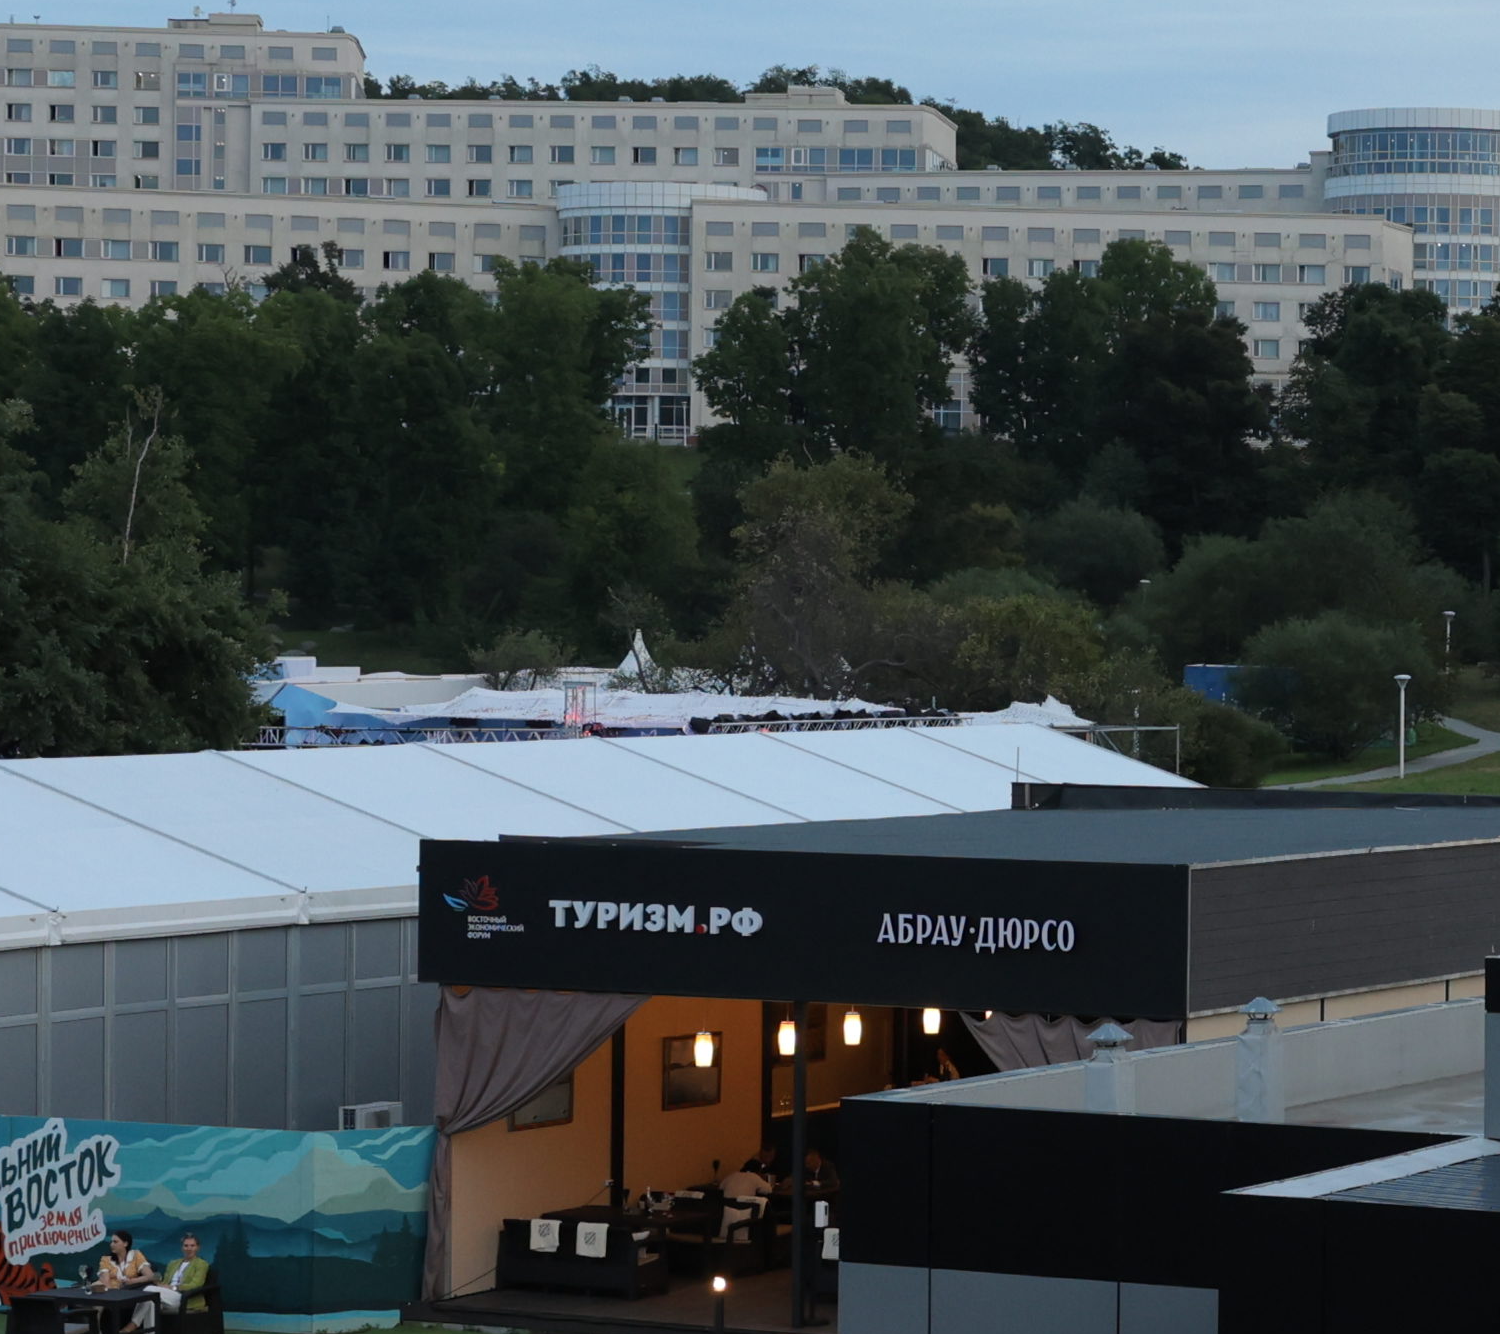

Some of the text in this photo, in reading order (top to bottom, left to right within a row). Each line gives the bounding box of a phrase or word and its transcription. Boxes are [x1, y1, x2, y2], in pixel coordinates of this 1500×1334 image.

[467, 915, 507, 924] ВОСТОЧНЫЙ
[549, 899, 763, 937] ТУРИЗМ.РФ
[467, 923, 524, 932] ЭКОНОМИЧЕСКИЙ
[467, 931, 491, 939] ФОРУМ
[5, 1141, 115, 1233] ВОСТОК
